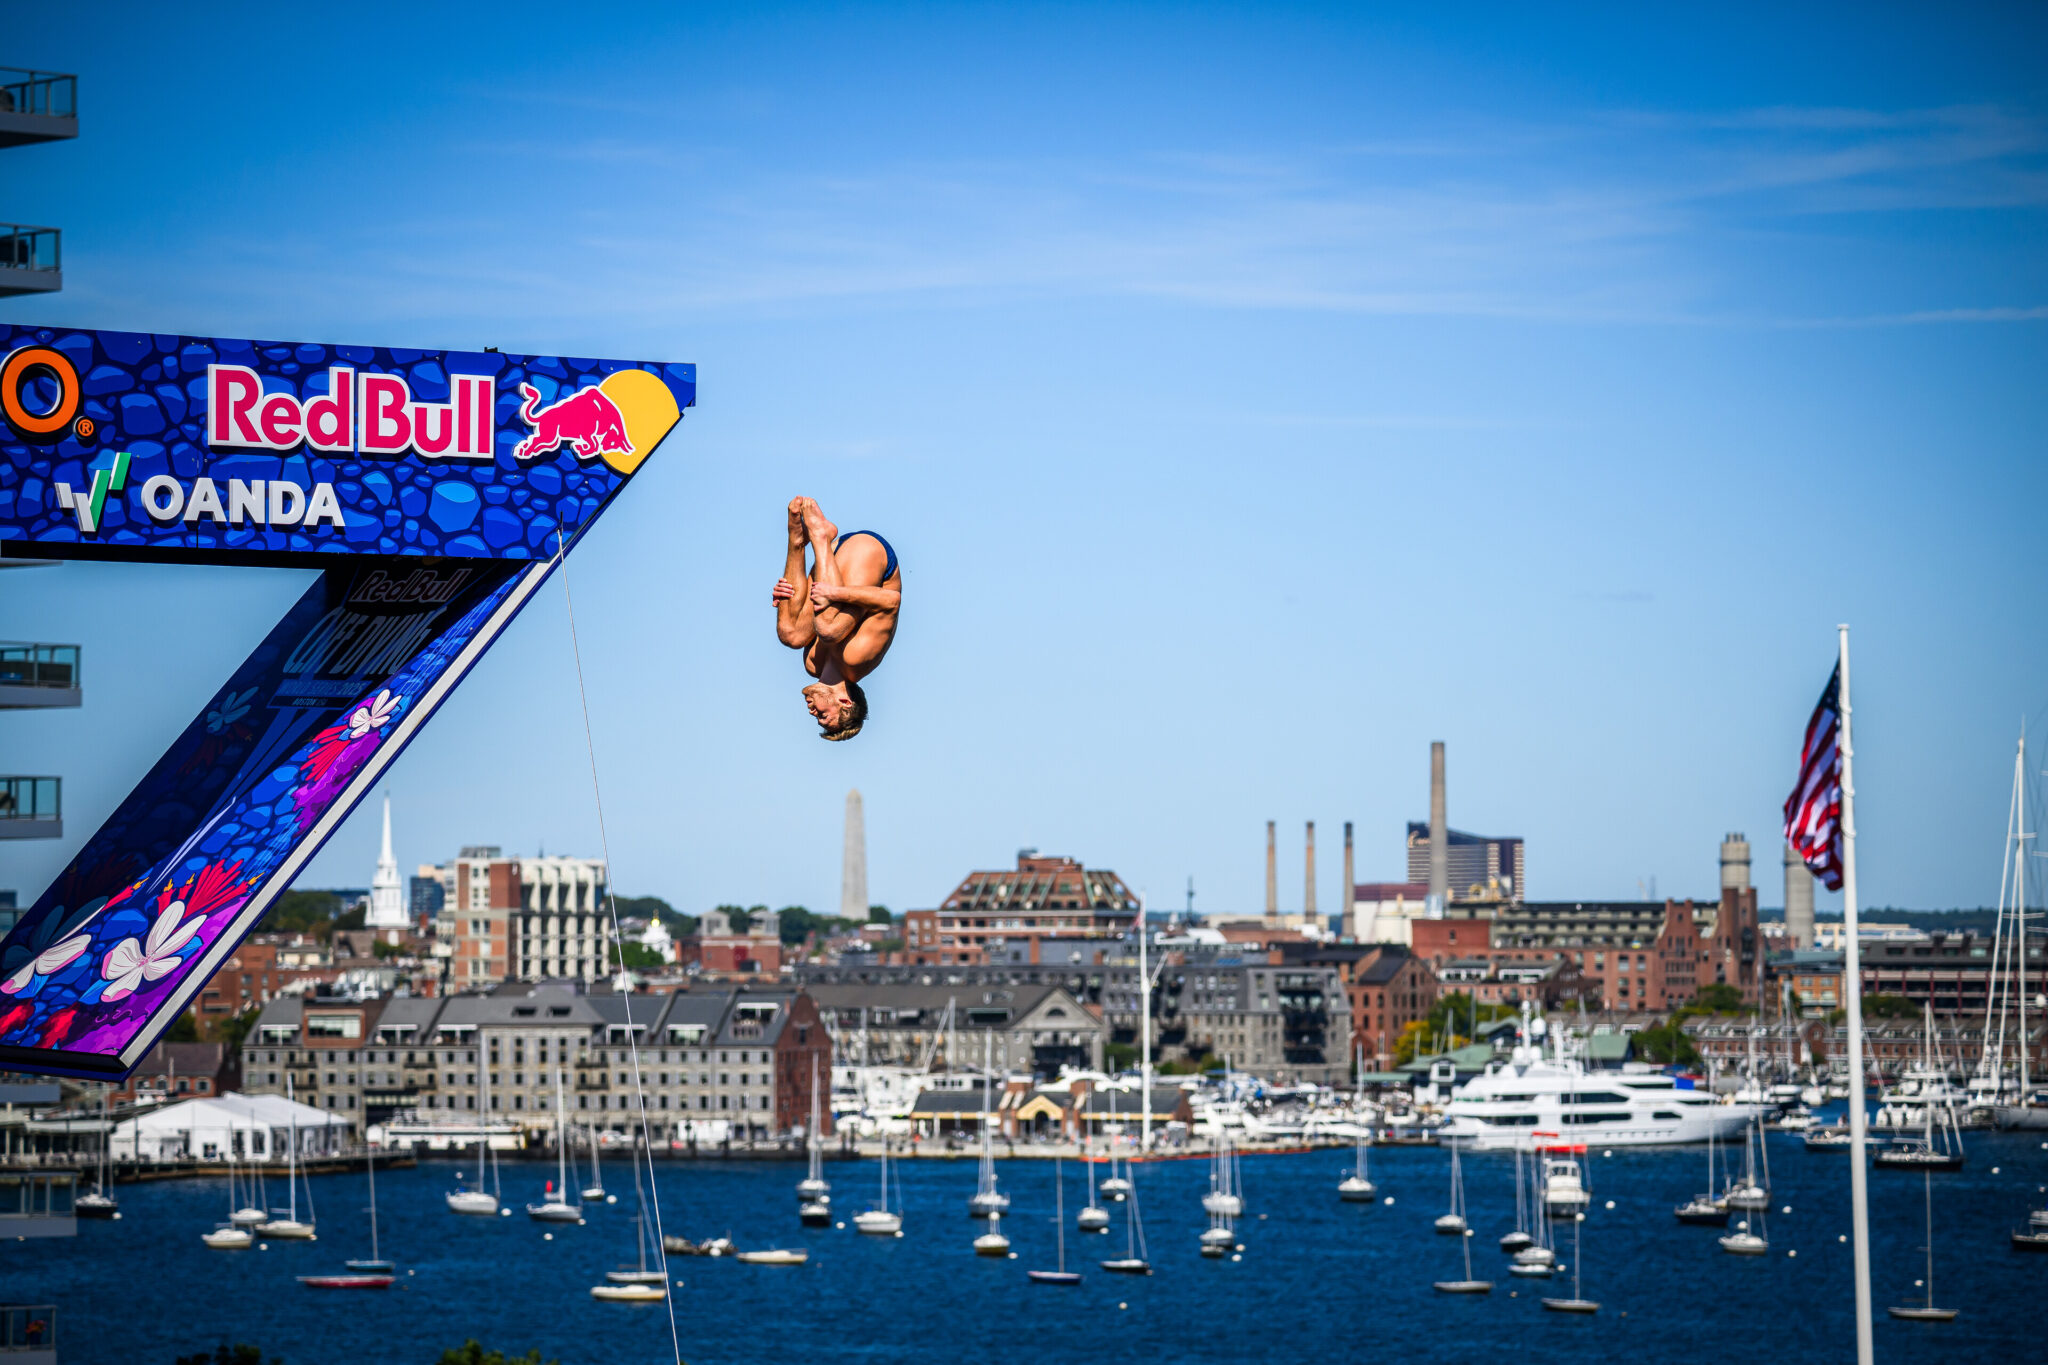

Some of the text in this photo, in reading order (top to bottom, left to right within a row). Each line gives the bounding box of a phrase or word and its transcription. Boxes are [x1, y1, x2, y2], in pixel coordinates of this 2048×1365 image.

[141, 475, 346, 527] OANDA
[283, 606, 447, 675] CLIFF DIVING
